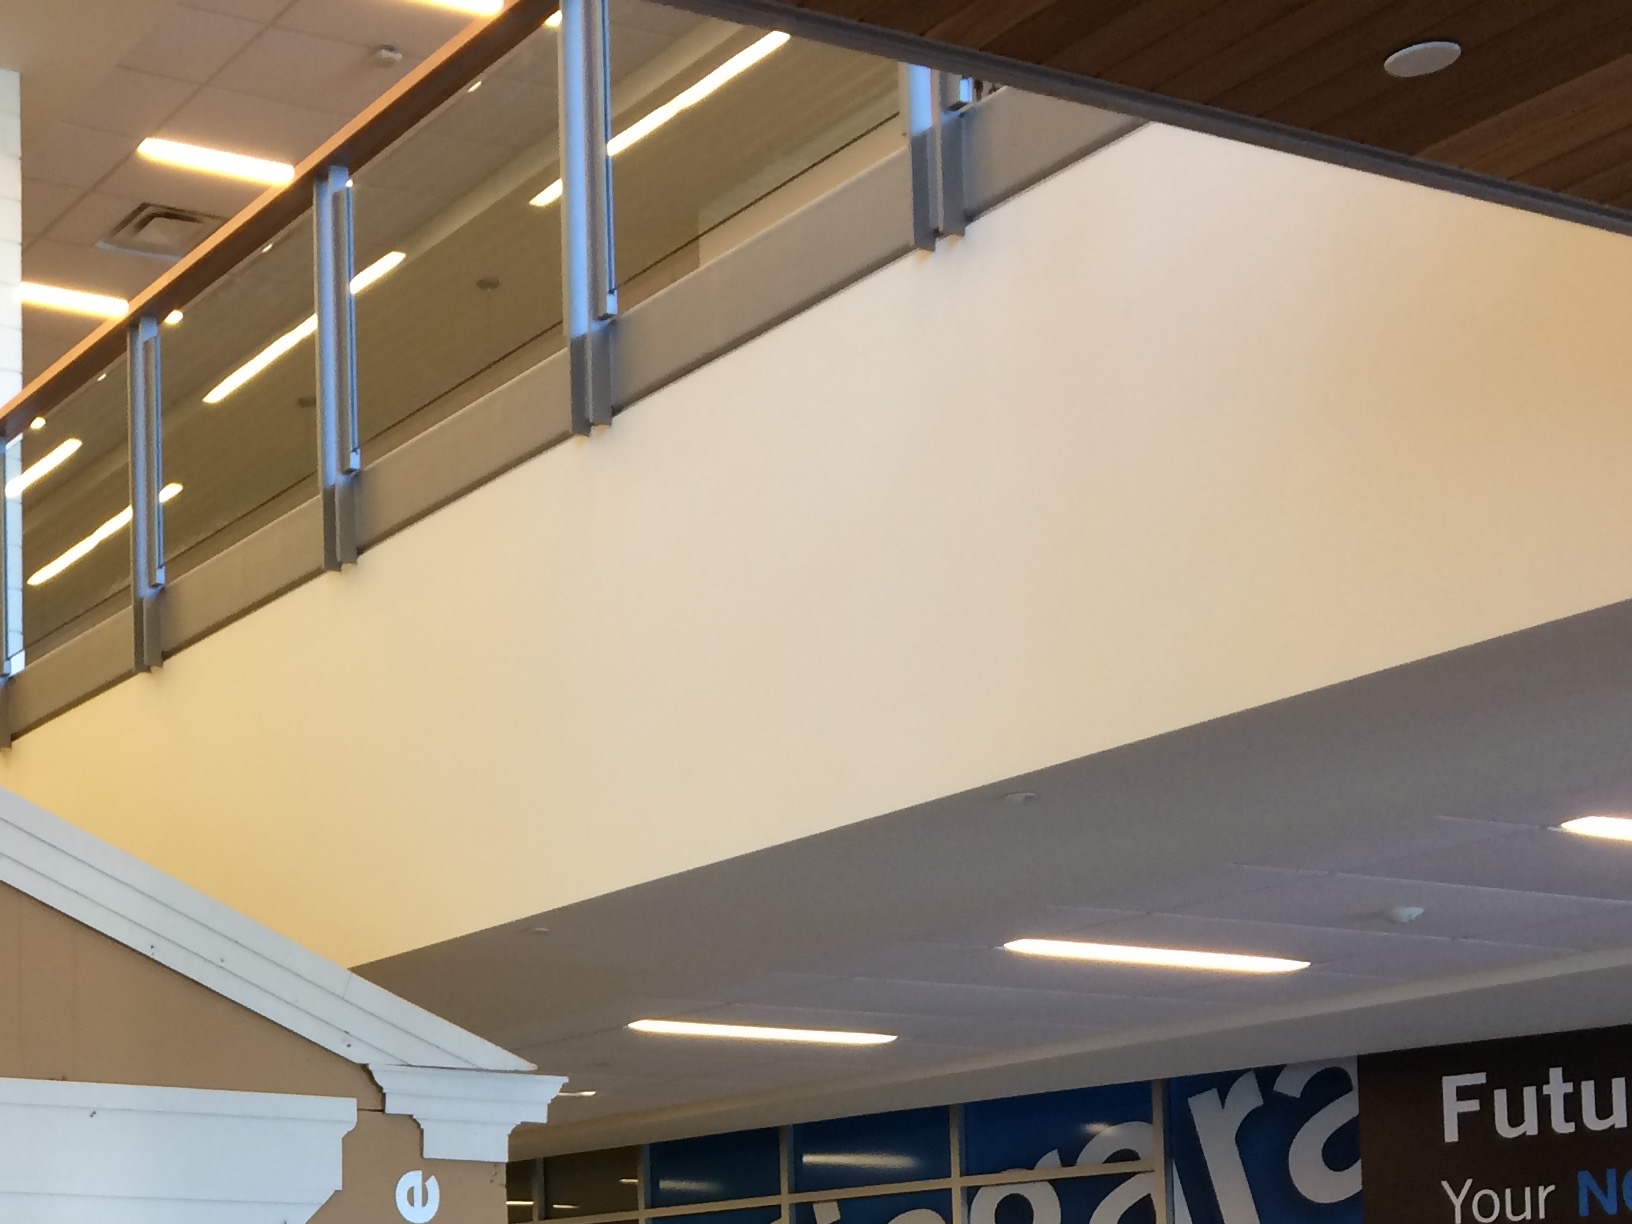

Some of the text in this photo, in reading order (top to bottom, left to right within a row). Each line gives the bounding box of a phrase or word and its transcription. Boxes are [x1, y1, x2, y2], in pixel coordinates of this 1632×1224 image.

[1441, 1066, 1629, 1144] Futu
[1440, 1167, 1632, 1224] Your N
